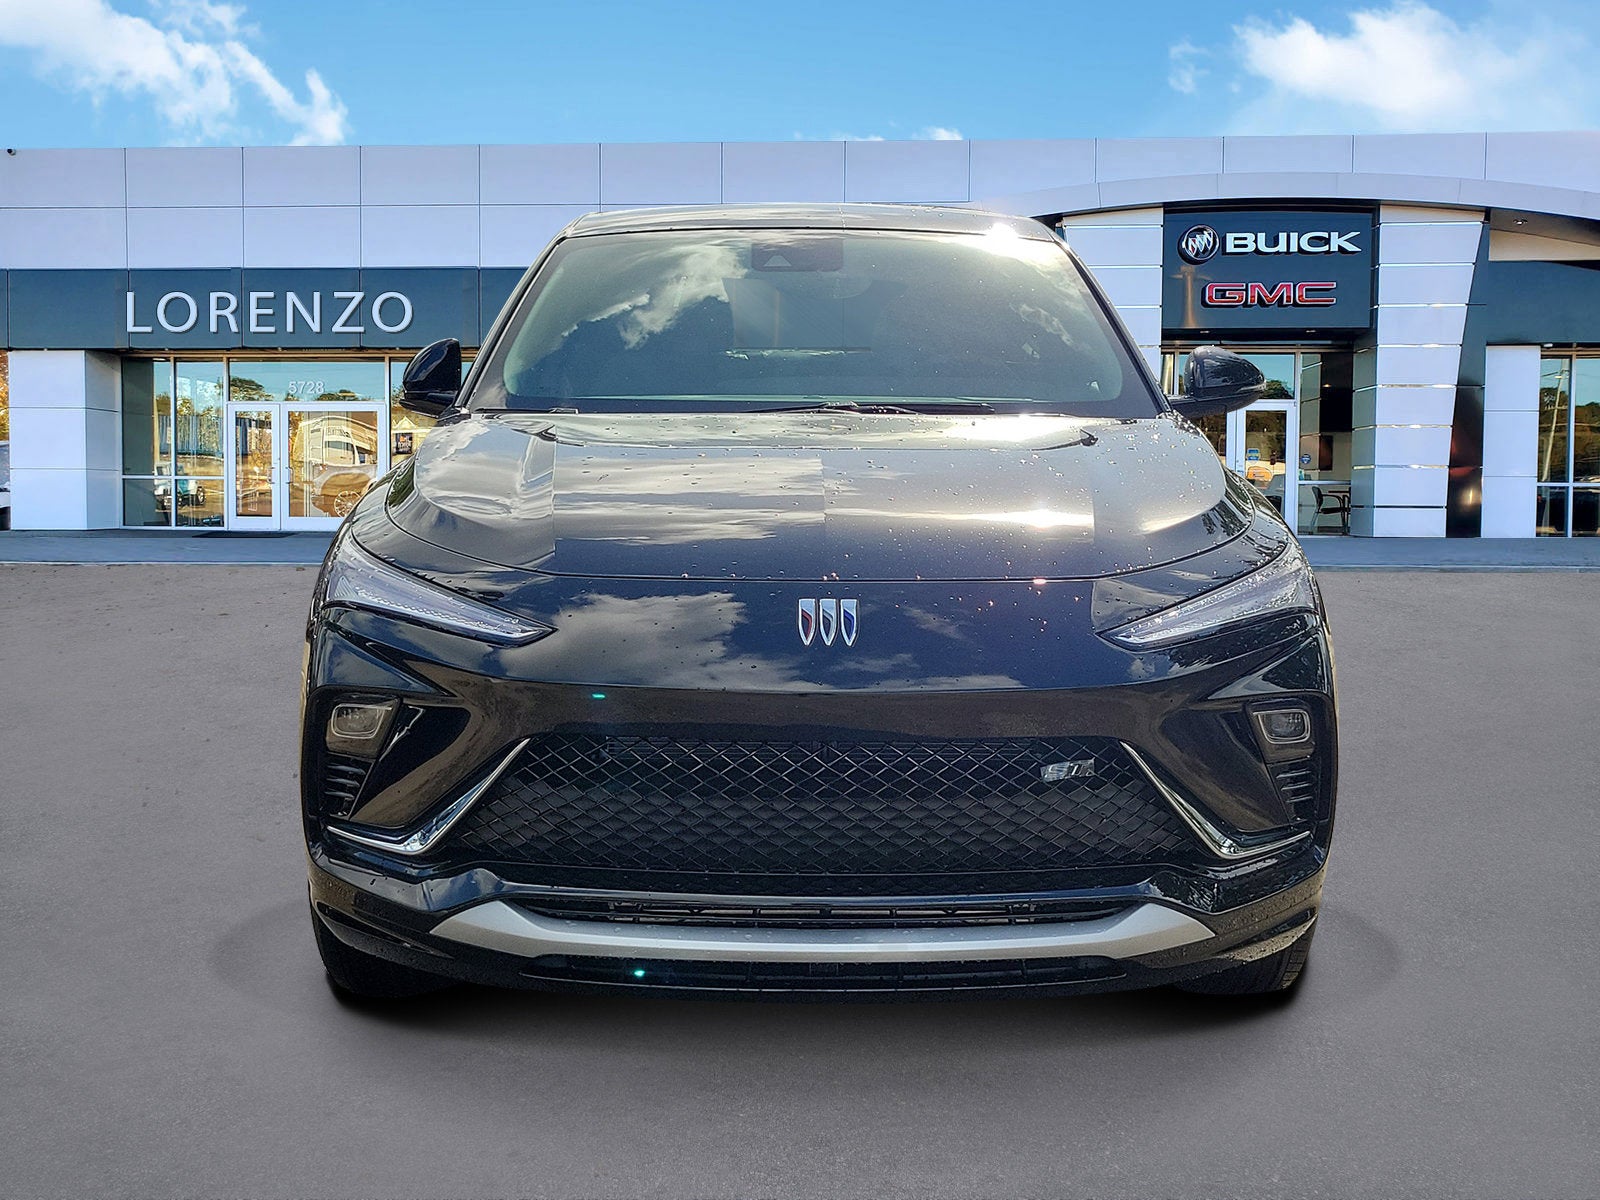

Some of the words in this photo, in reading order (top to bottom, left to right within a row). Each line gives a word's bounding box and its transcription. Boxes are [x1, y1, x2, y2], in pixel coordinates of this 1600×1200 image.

[1225, 231, 1362, 253] BUICK
[1205, 282, 1336, 305] GMC
[126, 291, 413, 333] LORENZO
[288, 381, 325, 394] 5728
